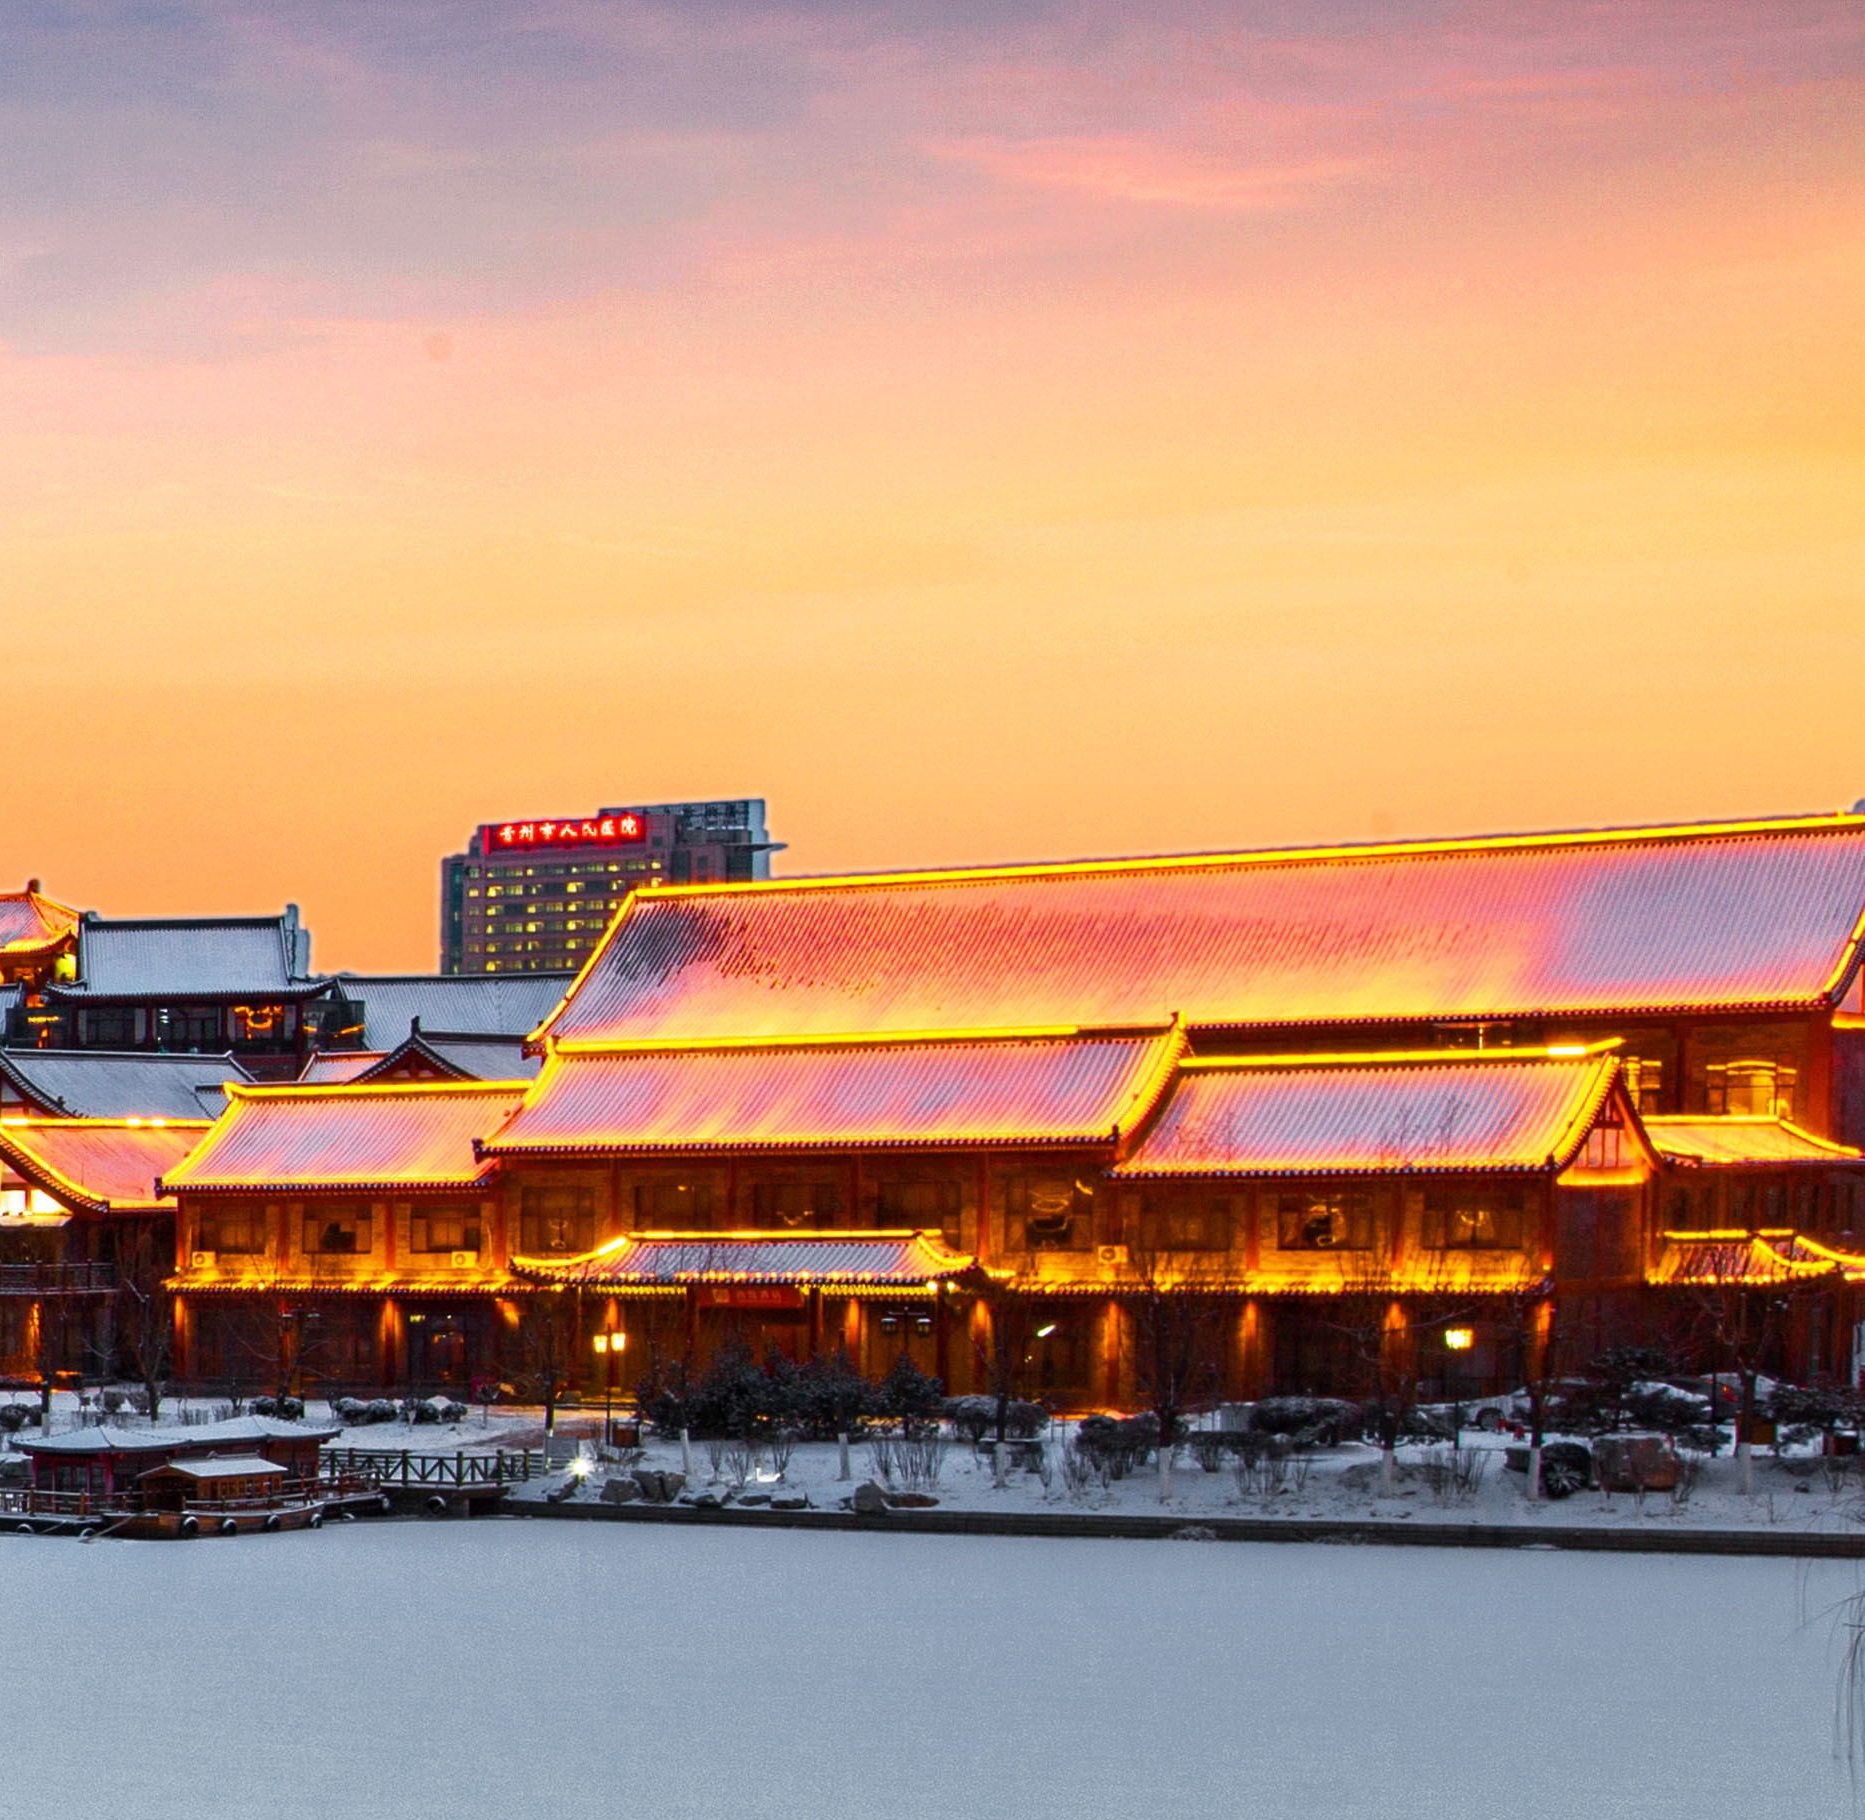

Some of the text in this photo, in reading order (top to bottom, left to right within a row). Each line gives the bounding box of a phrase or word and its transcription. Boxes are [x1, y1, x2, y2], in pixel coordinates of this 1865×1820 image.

[499, 817, 638, 842] 青州市人民医院
